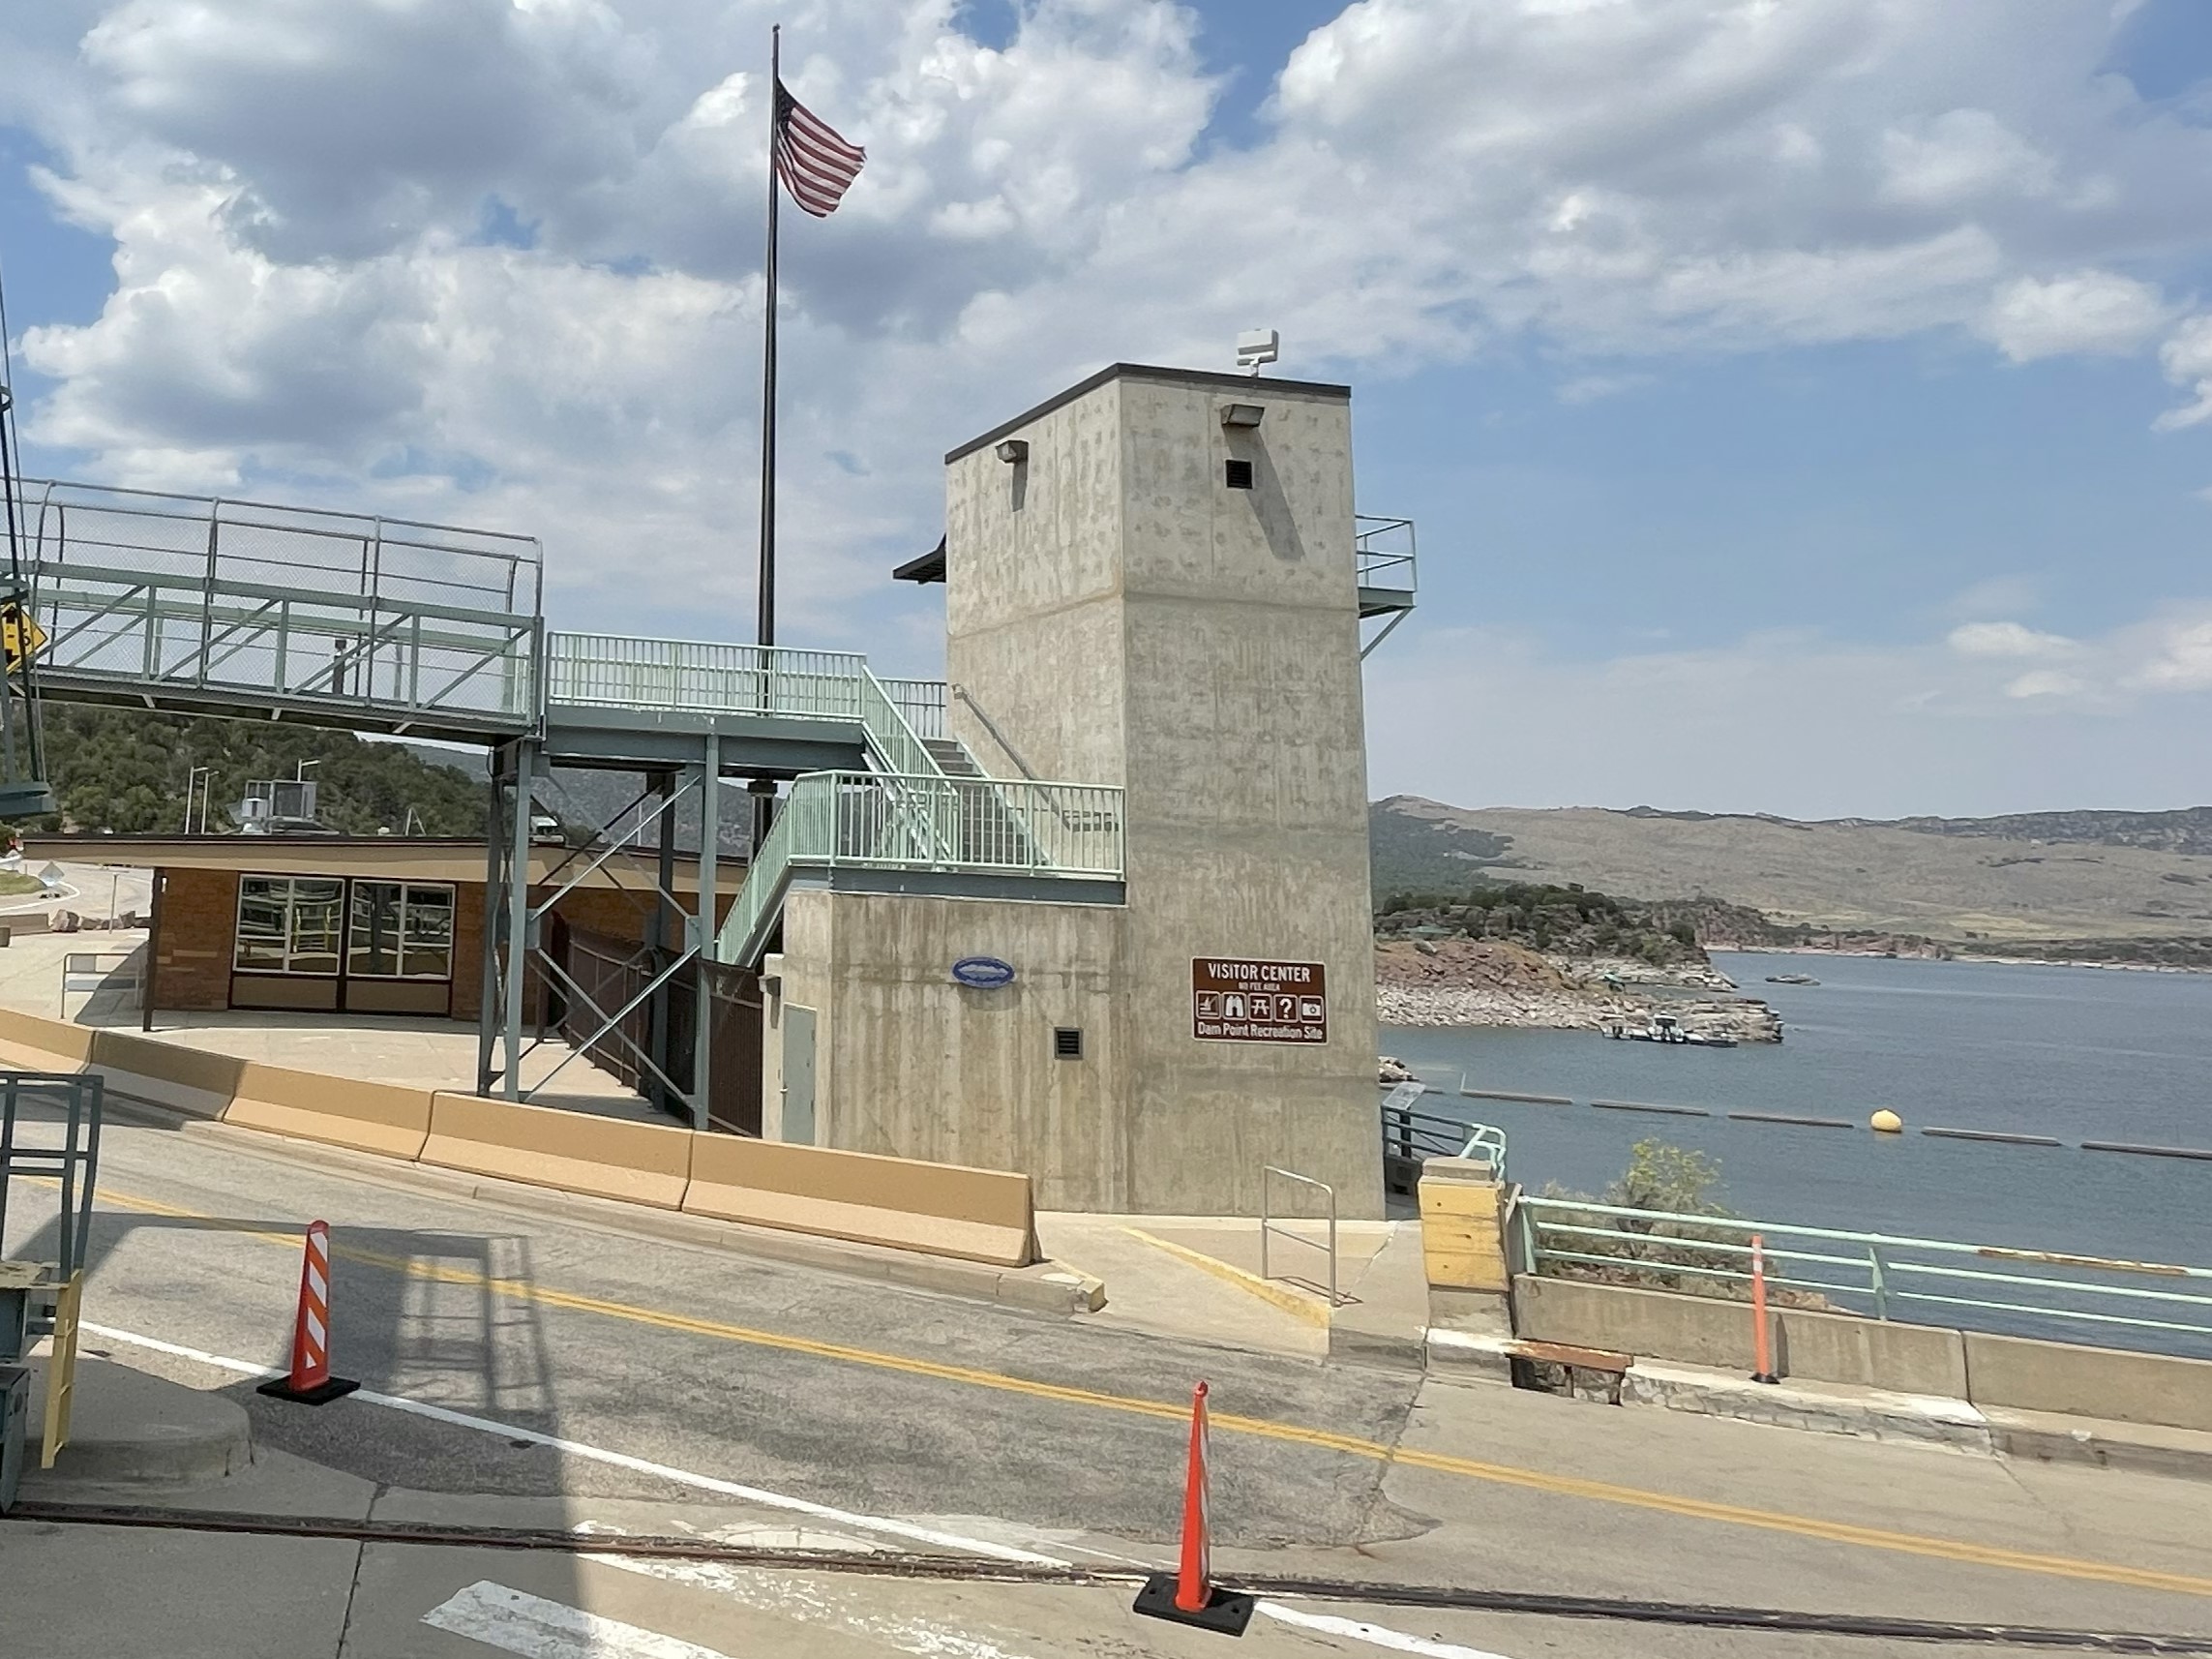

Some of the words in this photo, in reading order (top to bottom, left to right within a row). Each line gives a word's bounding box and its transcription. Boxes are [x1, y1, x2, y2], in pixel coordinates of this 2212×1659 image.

[1208, 963, 1258, 980] VISITOR
[1261, 965, 1310, 982] CENTER
[1198, 1021, 1221, 1036] Dam
[1223, 1022, 1249, 1037] Point
[1250, 1023, 1302, 1039] Recreation
[1303, 1025, 1323, 1040] Site
